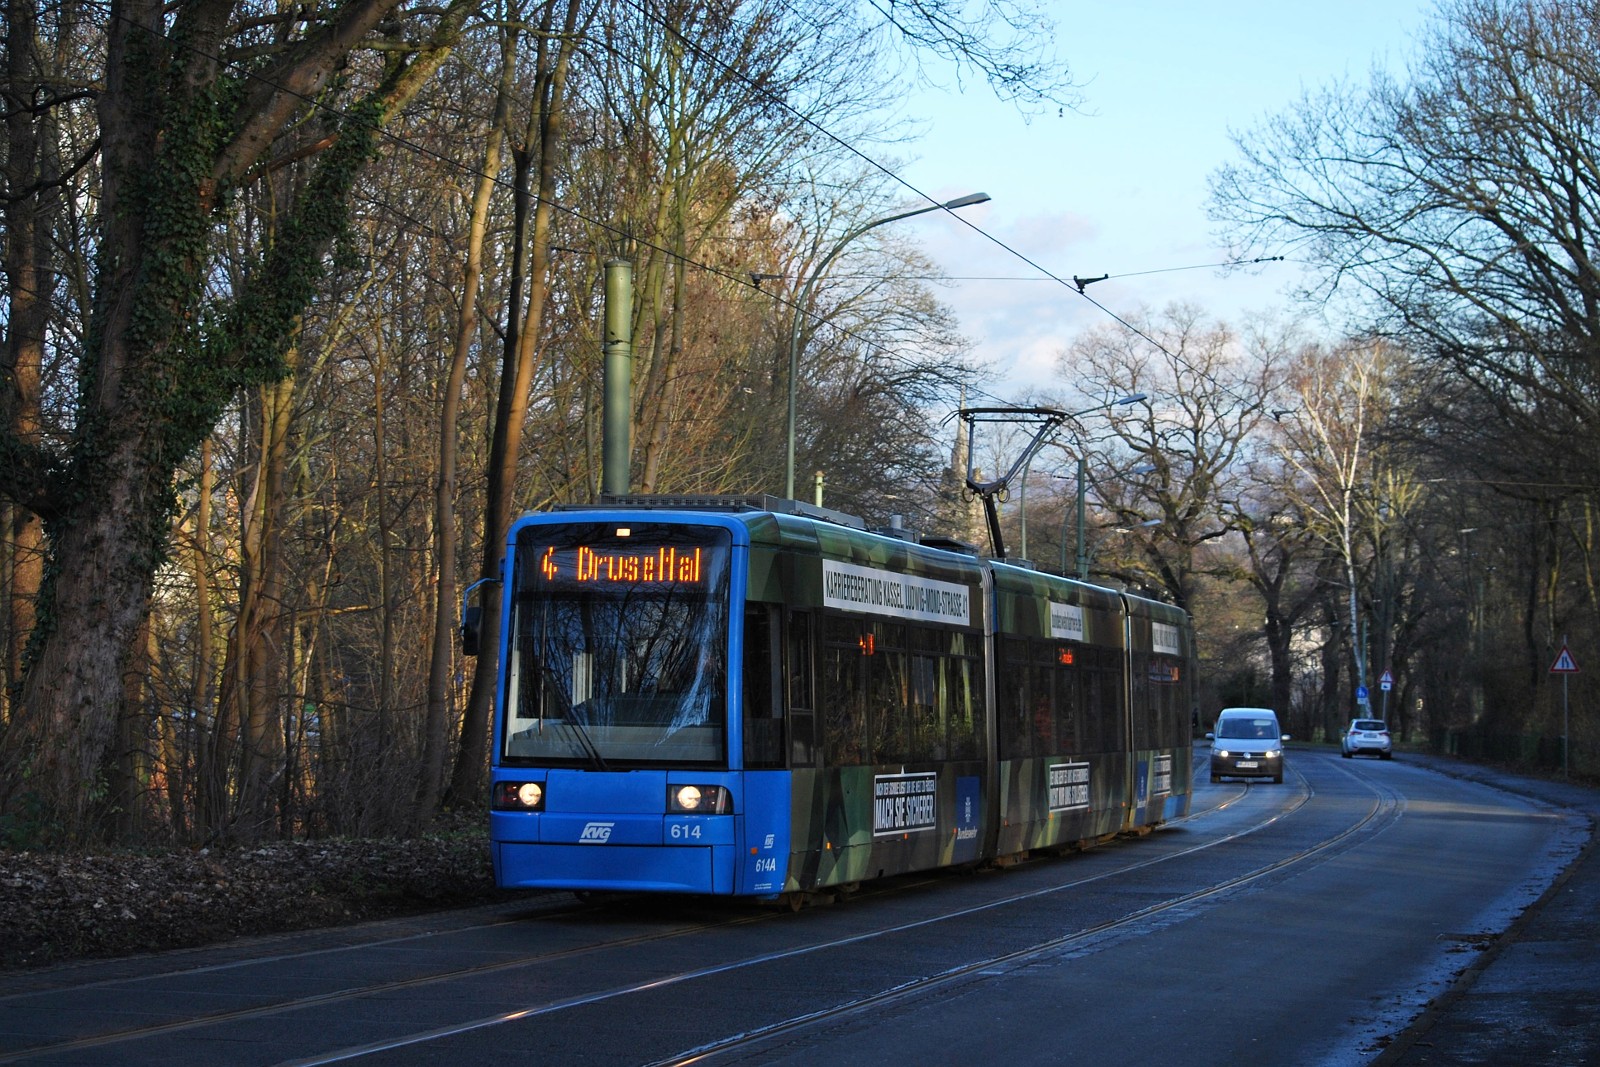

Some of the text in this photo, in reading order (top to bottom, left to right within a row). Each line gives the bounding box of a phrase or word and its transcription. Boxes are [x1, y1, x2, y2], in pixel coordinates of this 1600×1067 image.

[542, 546, 558, 581] 4
[825, 570, 882, 606] KARRIEREBERATUNG
[882, 580, 904, 613] KASSEL,
[876, 794, 934, 829] MACH SIE SICHERER.
[580, 824, 613, 842] KVG
[671, 824, 701, 839] 614
[755, 857, 776, 873] 614A
